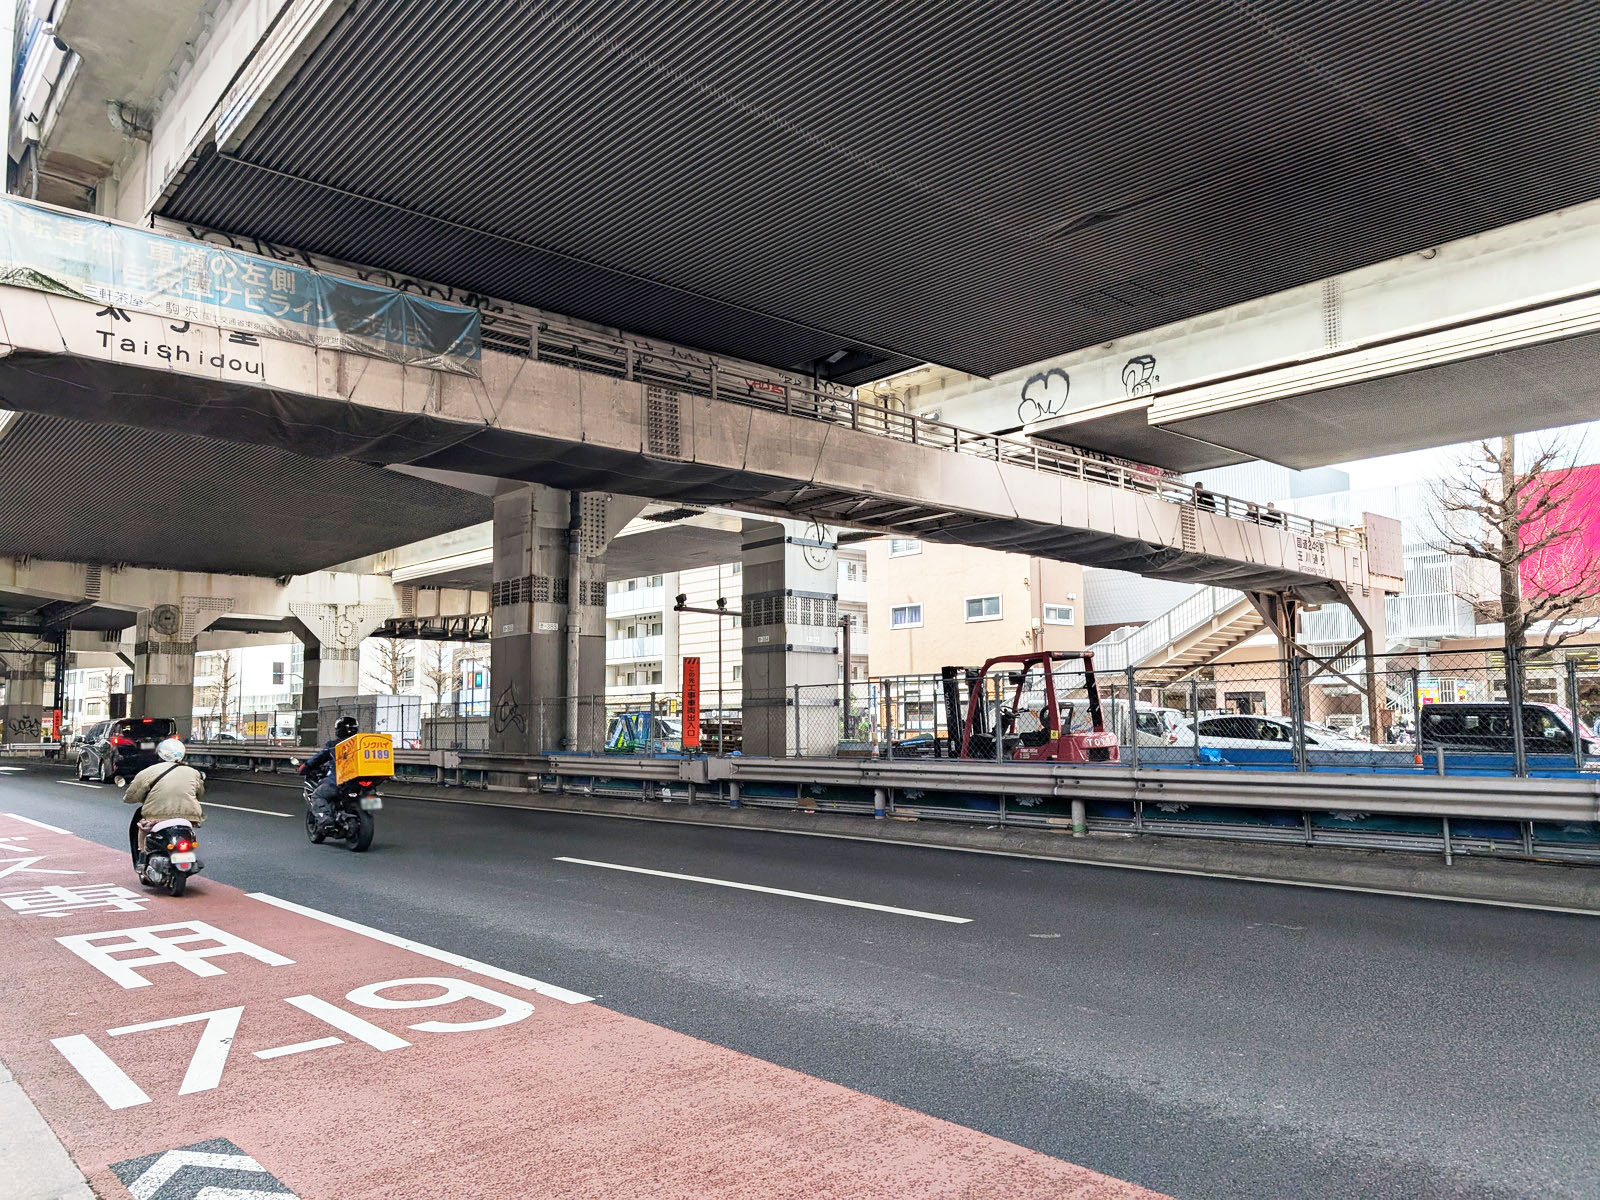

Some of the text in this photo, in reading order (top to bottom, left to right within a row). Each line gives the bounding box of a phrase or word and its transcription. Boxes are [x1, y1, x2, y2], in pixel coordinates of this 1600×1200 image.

[146, 240, 296, 295] 車道の左側
[95, 330, 259, 375] Taishidou
[687, 665, 697, 737] この先工事車両出入口
[364, 749, 390, 760] 0189
